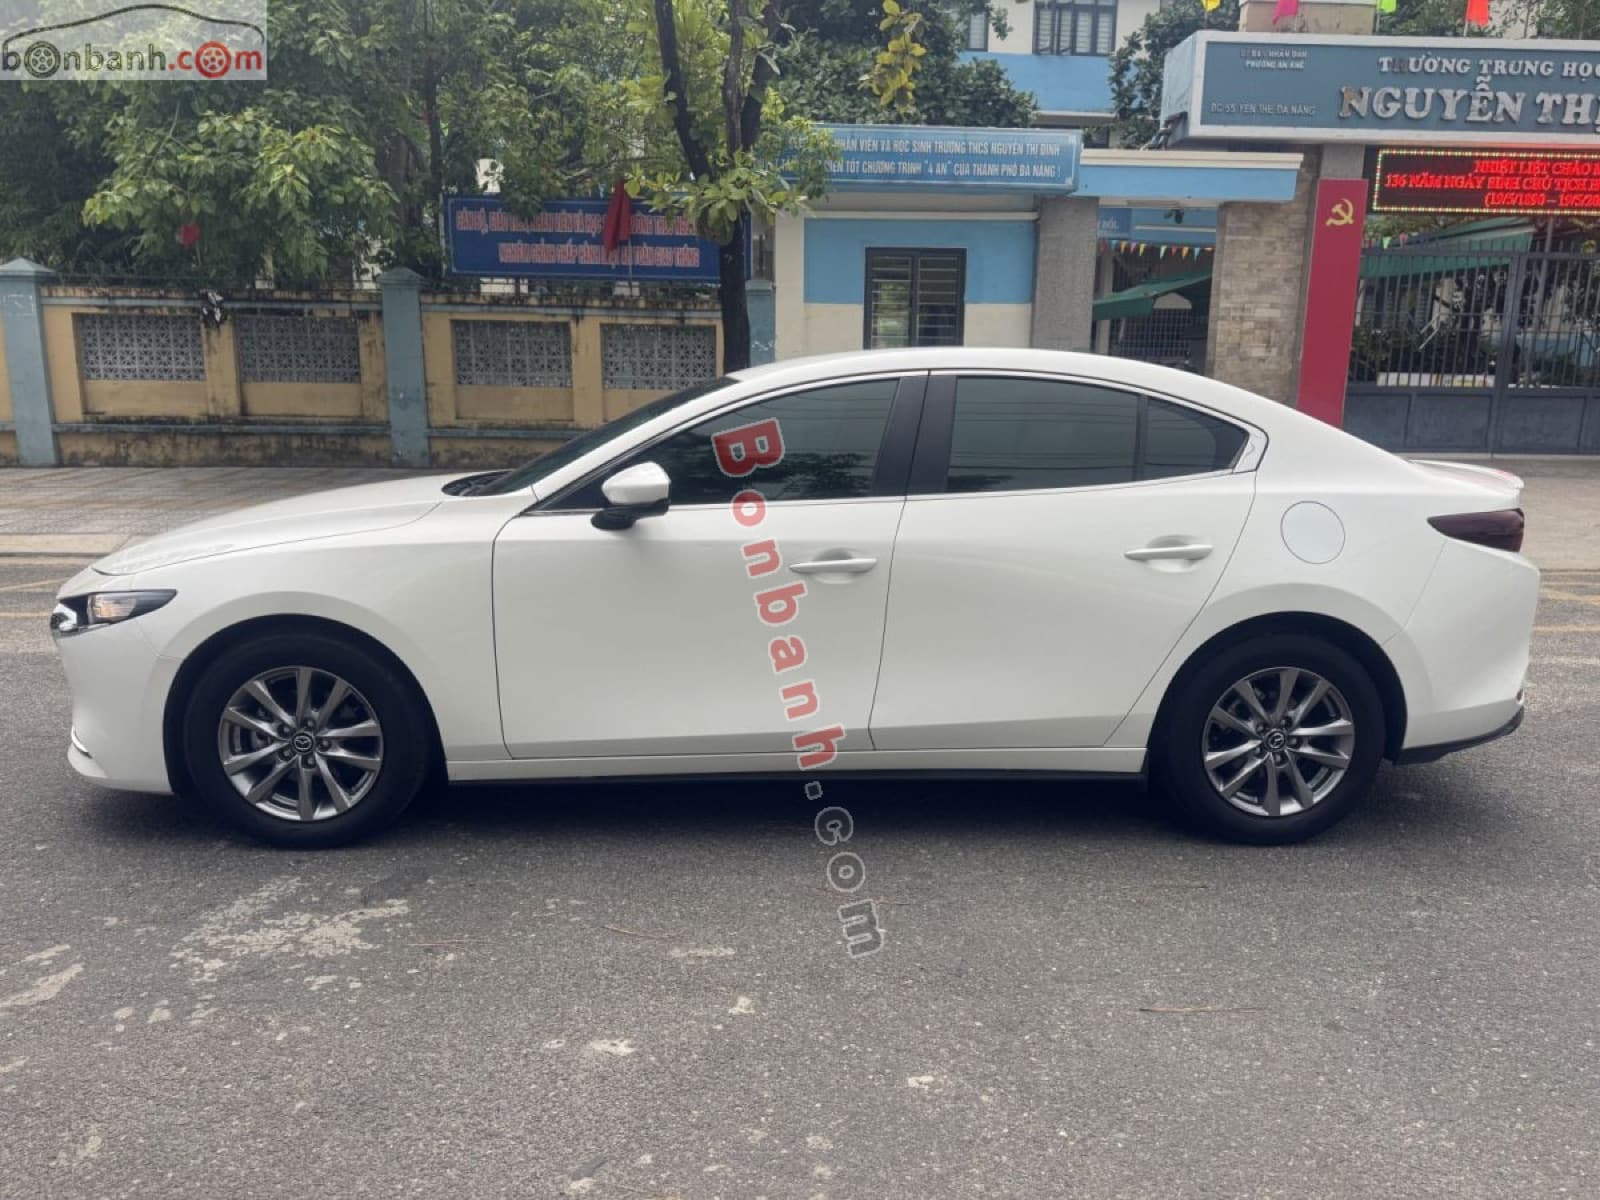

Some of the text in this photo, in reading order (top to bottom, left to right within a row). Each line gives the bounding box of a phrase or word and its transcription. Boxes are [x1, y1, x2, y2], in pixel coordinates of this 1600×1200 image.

[1379, 51, 1471, 73] TƯỜNG
[1478, 59, 1553, 76] TRUNG
[1338, 75, 1526, 123] NGUYỄN
